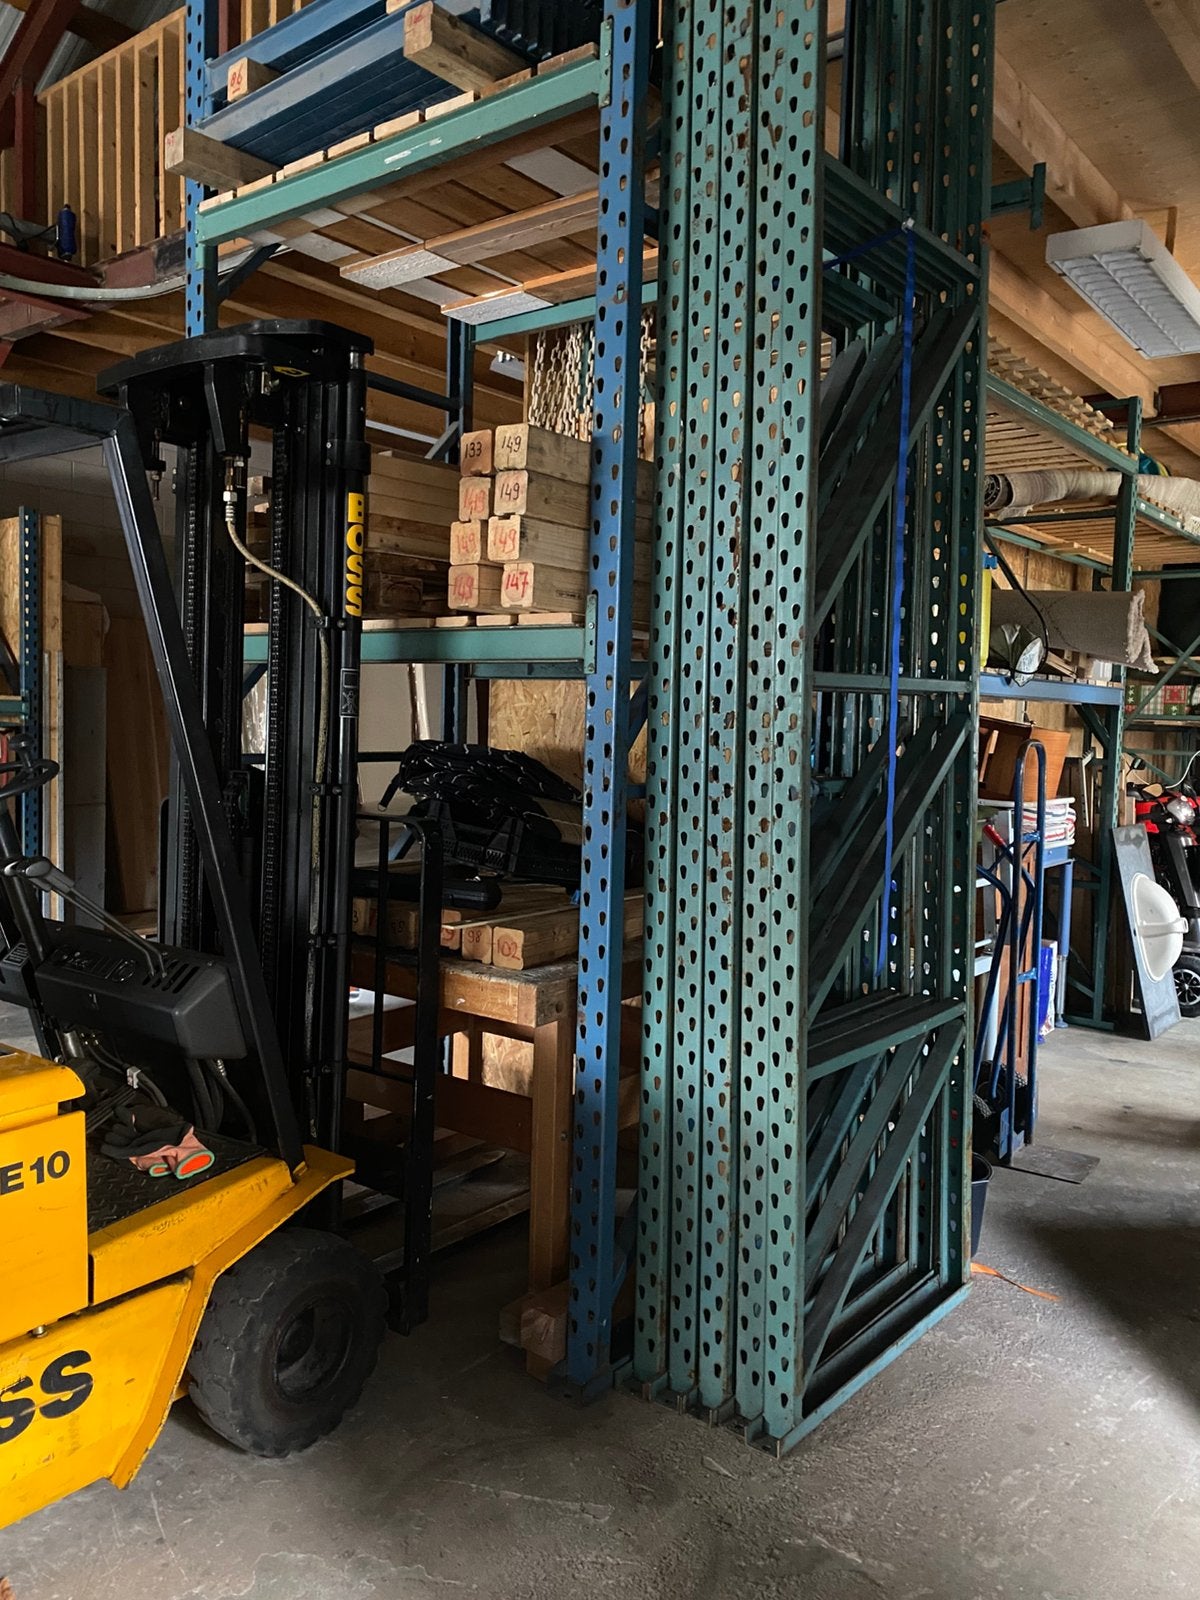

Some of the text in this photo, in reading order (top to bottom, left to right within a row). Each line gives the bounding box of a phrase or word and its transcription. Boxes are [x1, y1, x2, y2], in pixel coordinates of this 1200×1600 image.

[230, 63, 244, 87] 86
[464, 441, 482, 458] 133
[501, 435, 521, 454] 149
[500, 482, 520, 501] 149
[345, 492, 364, 617] BOSS
[505, 571, 529, 599] 147
[467, 929, 482, 943] 98
[496, 941, 521, 960] 102
